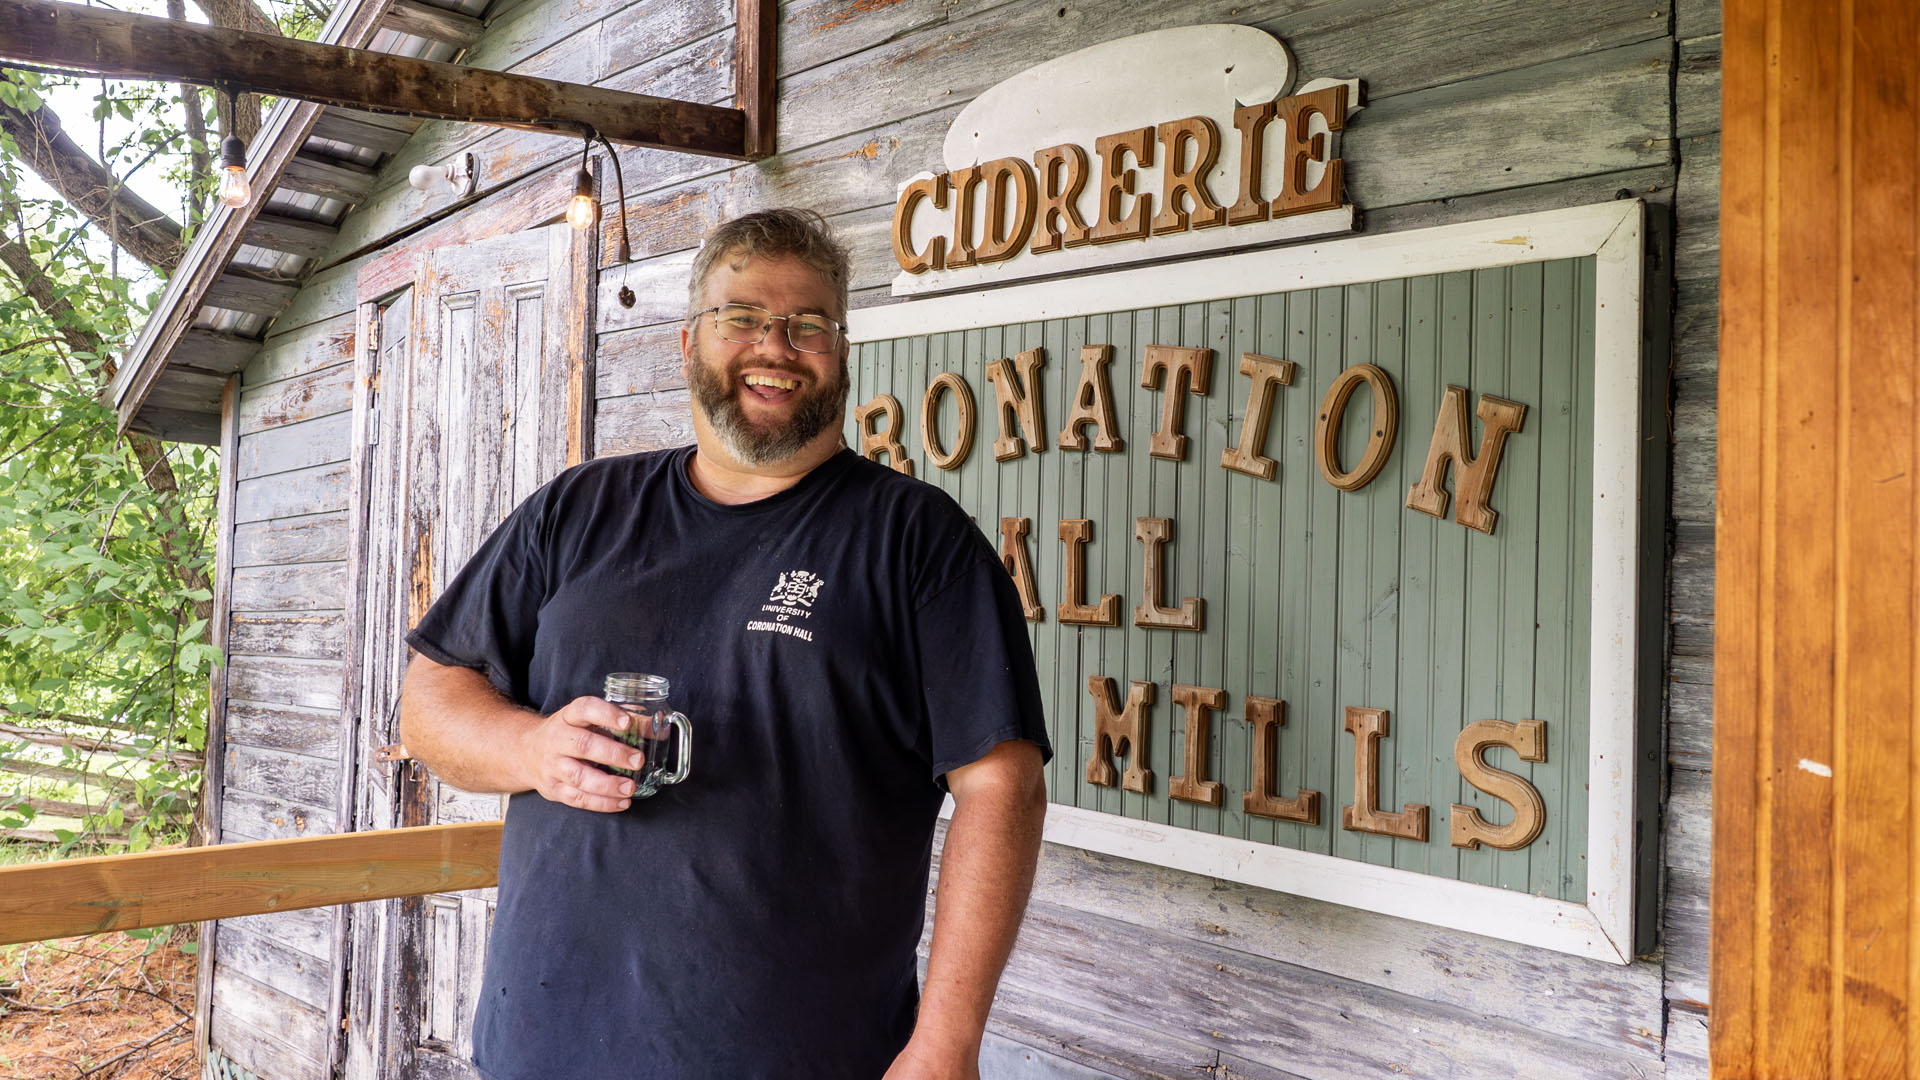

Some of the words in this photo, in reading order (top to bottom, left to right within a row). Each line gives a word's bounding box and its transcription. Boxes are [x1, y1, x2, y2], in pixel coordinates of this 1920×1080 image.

[892, 84, 1348, 274] CIDRERIE
[747, 621, 793, 635] CORONATION
[793, 627, 813, 641] HALL
[762, 605, 811, 618] UNIVERSITY
[970, 516, 1206, 631] ALL
[1087, 675, 1547, 851] MILLS
